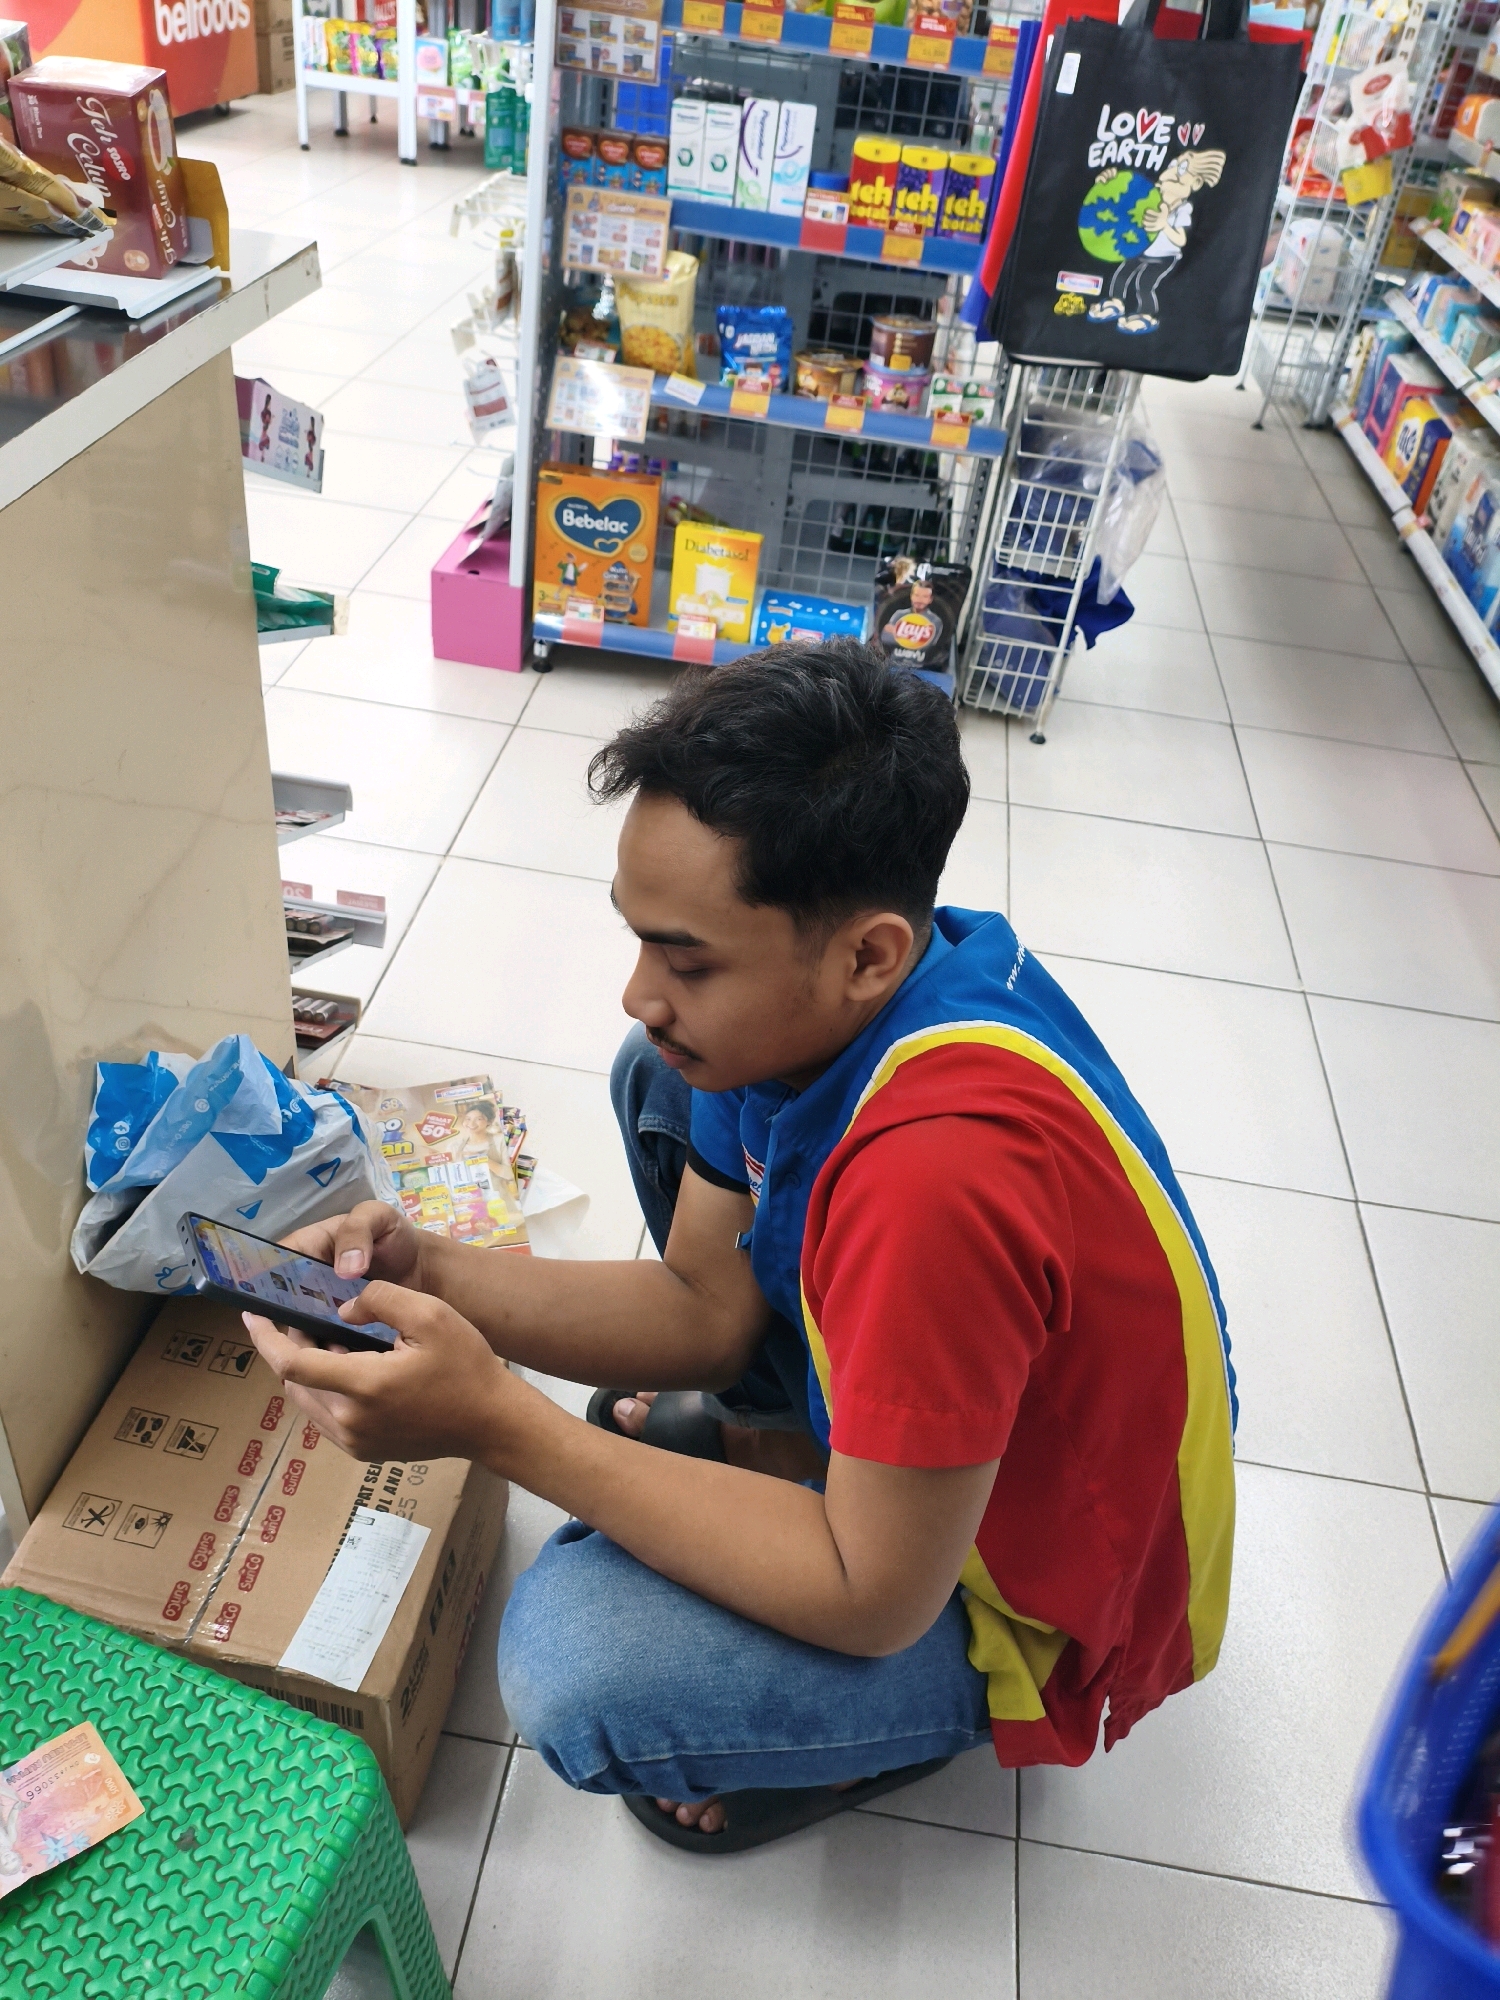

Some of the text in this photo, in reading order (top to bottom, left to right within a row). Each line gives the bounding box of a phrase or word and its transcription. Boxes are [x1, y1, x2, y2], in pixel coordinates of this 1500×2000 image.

[76, 96, 118, 145] Teh
[1097, 103, 1175, 144] LOVE
[66, 132, 112, 198] Celup
[106, 147, 131, 181] SOSRO
[1087, 141, 1168, 172] EARTH
[851, 176, 893, 207] teh
[896, 184, 938, 213] teh
[944, 190, 986, 220] teh
[562, 509, 629, 534] Bebelac
[684, 538, 750, 561] Diabetasol
[263, 1396, 284, 1429] SunCo
[240, 1441, 262, 1474] SunCo
[285, 1461, 304, 1495] SunCo
[383, 1466, 404, 1496] AND
[217, 1487, 239, 1520] SunCo
[262, 1508, 284, 1542] SunCo
[192, 1534, 214, 1568] SunCo
[240, 1555, 262, 1589] SunCo
[165, 1582, 189, 1618] SunCo
